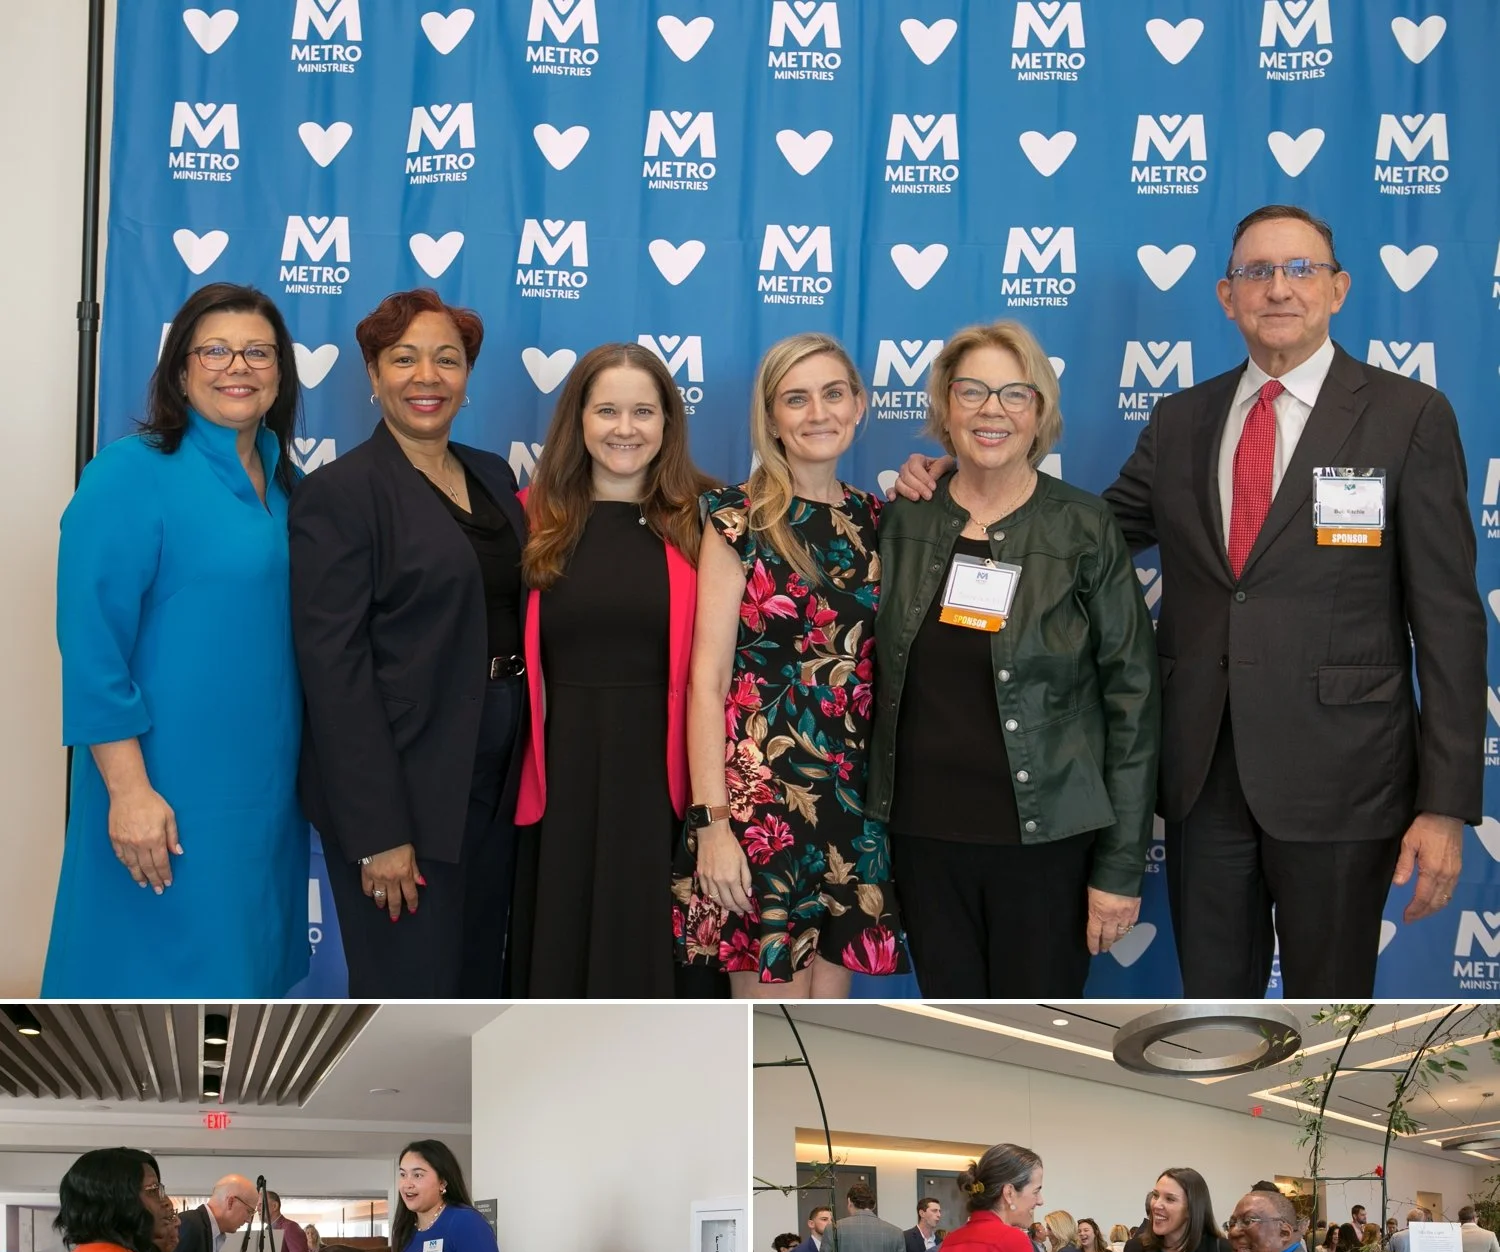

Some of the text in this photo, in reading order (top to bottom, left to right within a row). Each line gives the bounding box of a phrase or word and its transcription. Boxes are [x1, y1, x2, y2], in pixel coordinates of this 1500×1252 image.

[290, 44, 362, 62] METRO
[526, 45, 599, 65] METRO
[767, 51, 842, 70] METRO
[1259, 48, 1333, 70] METRO
[297, 62, 355, 73] MINISTRIES
[1010, 52, 1086, 70] METRO
[532, 64, 592, 77] MINISTRIES
[774, 70, 834, 81] MINISTRIES
[1017, 70, 1078, 82] MINISTRIES
[1266, 67, 1326, 81] MINISTRIES
[168, 151, 240, 171] METRO
[405, 152, 476, 174] METRO
[173, 170, 232, 182] MINISTRIES
[408, 171, 468, 184] MINISTRIES
[642, 160, 717, 180] METRO
[884, 164, 959, 182] METRO
[1131, 165, 1207, 183] METRO
[1374, 164, 1449, 184] METRO
[648, 179, 709, 191] MINISTRIES
[890, 183, 951, 194] MINISTRIES
[1137, 184, 1199, 195] MINISTRIES
[1380, 184, 1441, 195] MINISTRIES
[279, 265, 350, 284] METRO
[516, 268, 588, 289] METRO
[285, 284, 342, 295] MINISTRIES
[757, 274, 833, 294] METRO
[1001, 277, 1076, 295] METRO
[521, 288, 580, 300] MINISTRIES
[763, 294, 824, 306] MINISTRIES
[1007, 296, 1069, 307] MINISTRIES
[871, 391, 932, 408] METR
[1118, 392, 1173, 409] MET
[877, 410, 927, 420] MINISTRI
[1331, 533, 1368, 544] SPONSOR
[953, 614, 988, 629] SPONSOR
[1453, 960, 1500, 978] MET
[1460, 979, 1500, 990] MINIST
[207, 1113, 227, 1129] EXIT
